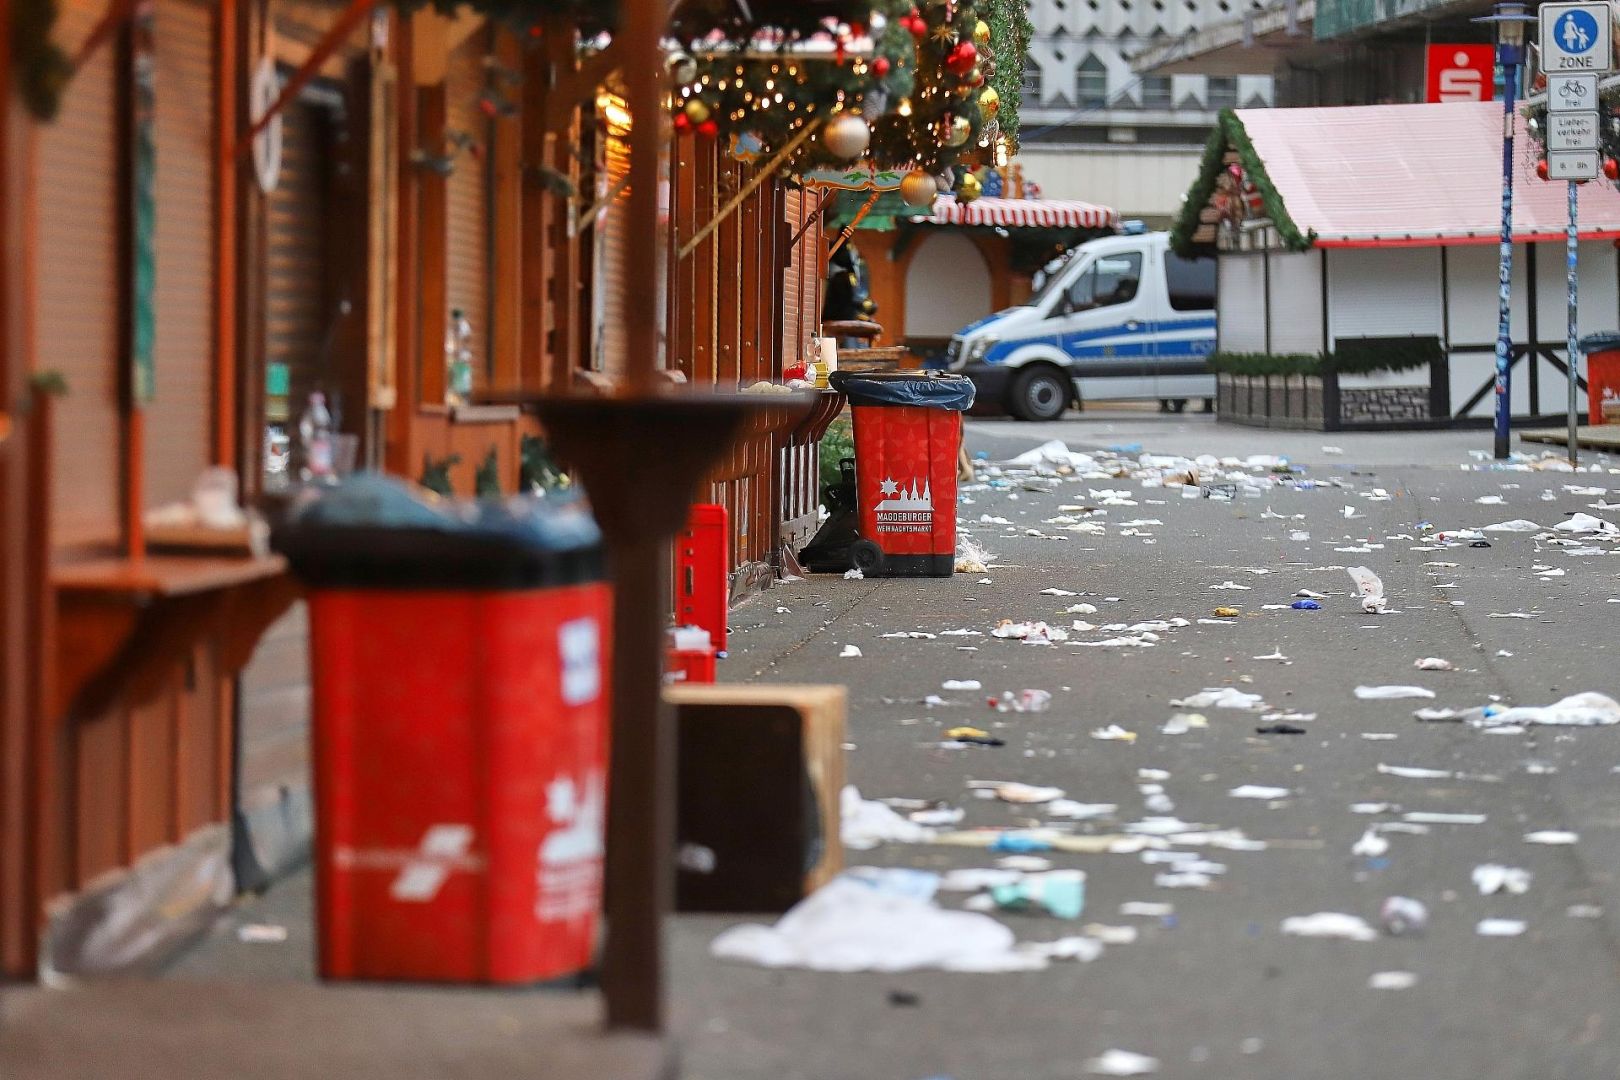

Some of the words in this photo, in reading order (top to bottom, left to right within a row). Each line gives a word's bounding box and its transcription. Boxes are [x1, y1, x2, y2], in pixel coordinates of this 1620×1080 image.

[1559, 56, 1593, 68] ZONE
[877, 512, 932, 522] MAGDEBURGER
[877, 525, 932, 533] WEIHNACHTSMARKT
